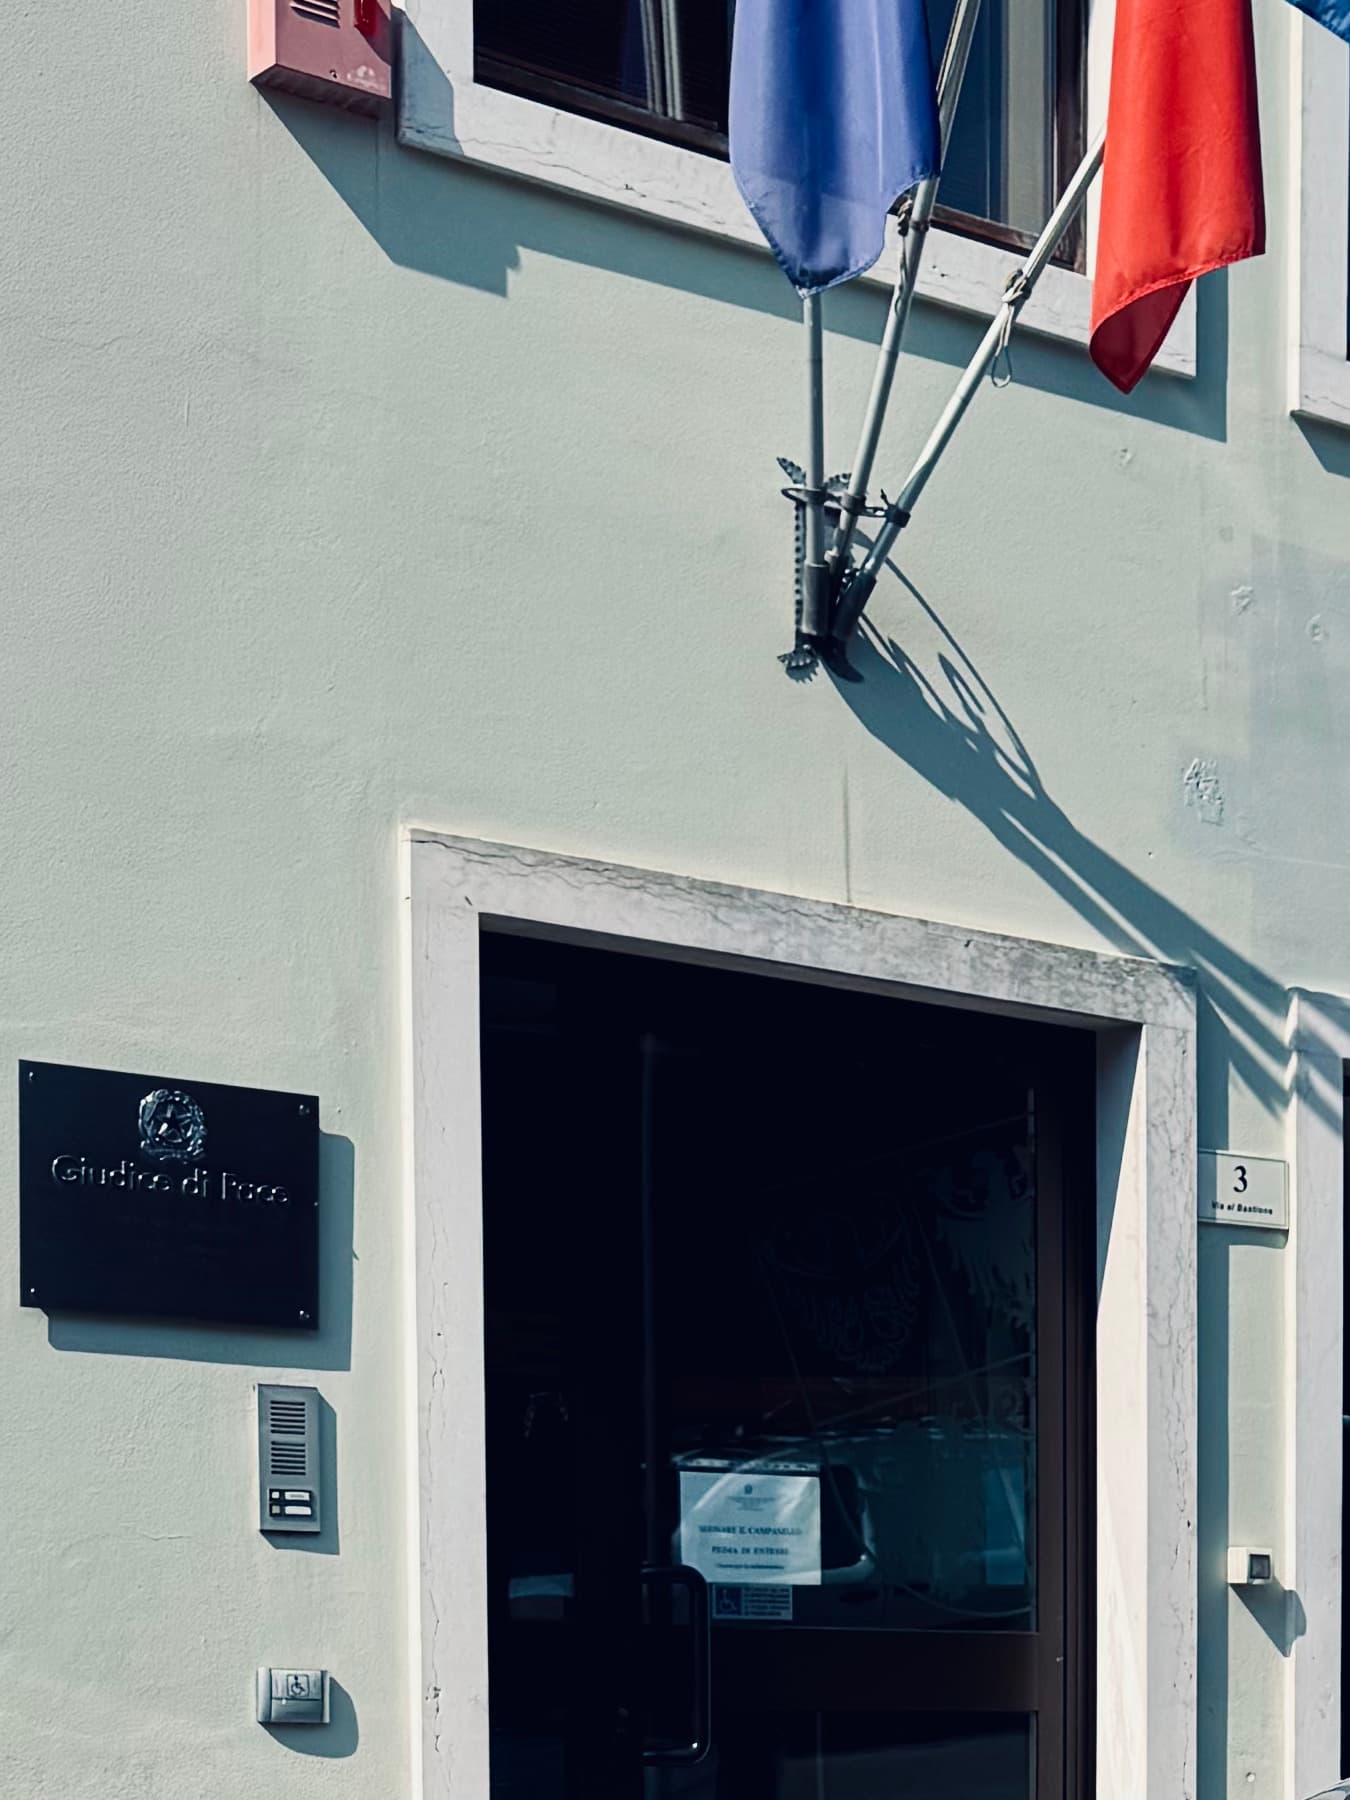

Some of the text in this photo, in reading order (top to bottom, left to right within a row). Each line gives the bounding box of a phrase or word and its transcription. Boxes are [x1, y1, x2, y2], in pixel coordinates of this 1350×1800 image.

[52, 1154, 171, 1193] Giudice
[181, 1167, 209, 1198] di
[1233, 1165, 1248, 1193] 3
